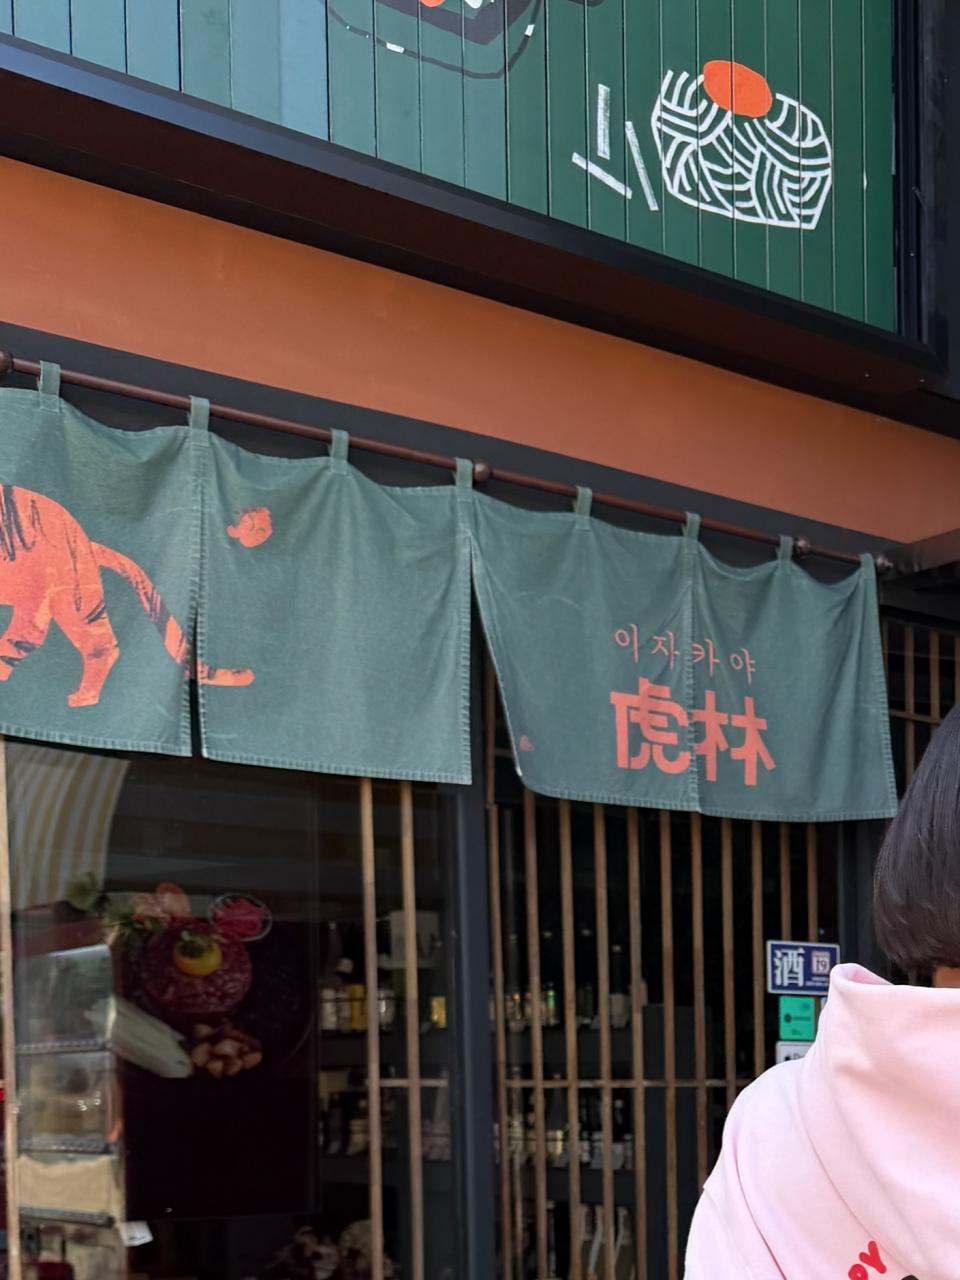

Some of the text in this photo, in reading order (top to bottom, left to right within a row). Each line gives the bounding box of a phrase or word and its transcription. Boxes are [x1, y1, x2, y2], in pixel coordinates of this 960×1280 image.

[613, 623, 757, 685] 이자카야
[609, 676, 777, 787] 虎林
[773, 947, 806, 987] 酒
